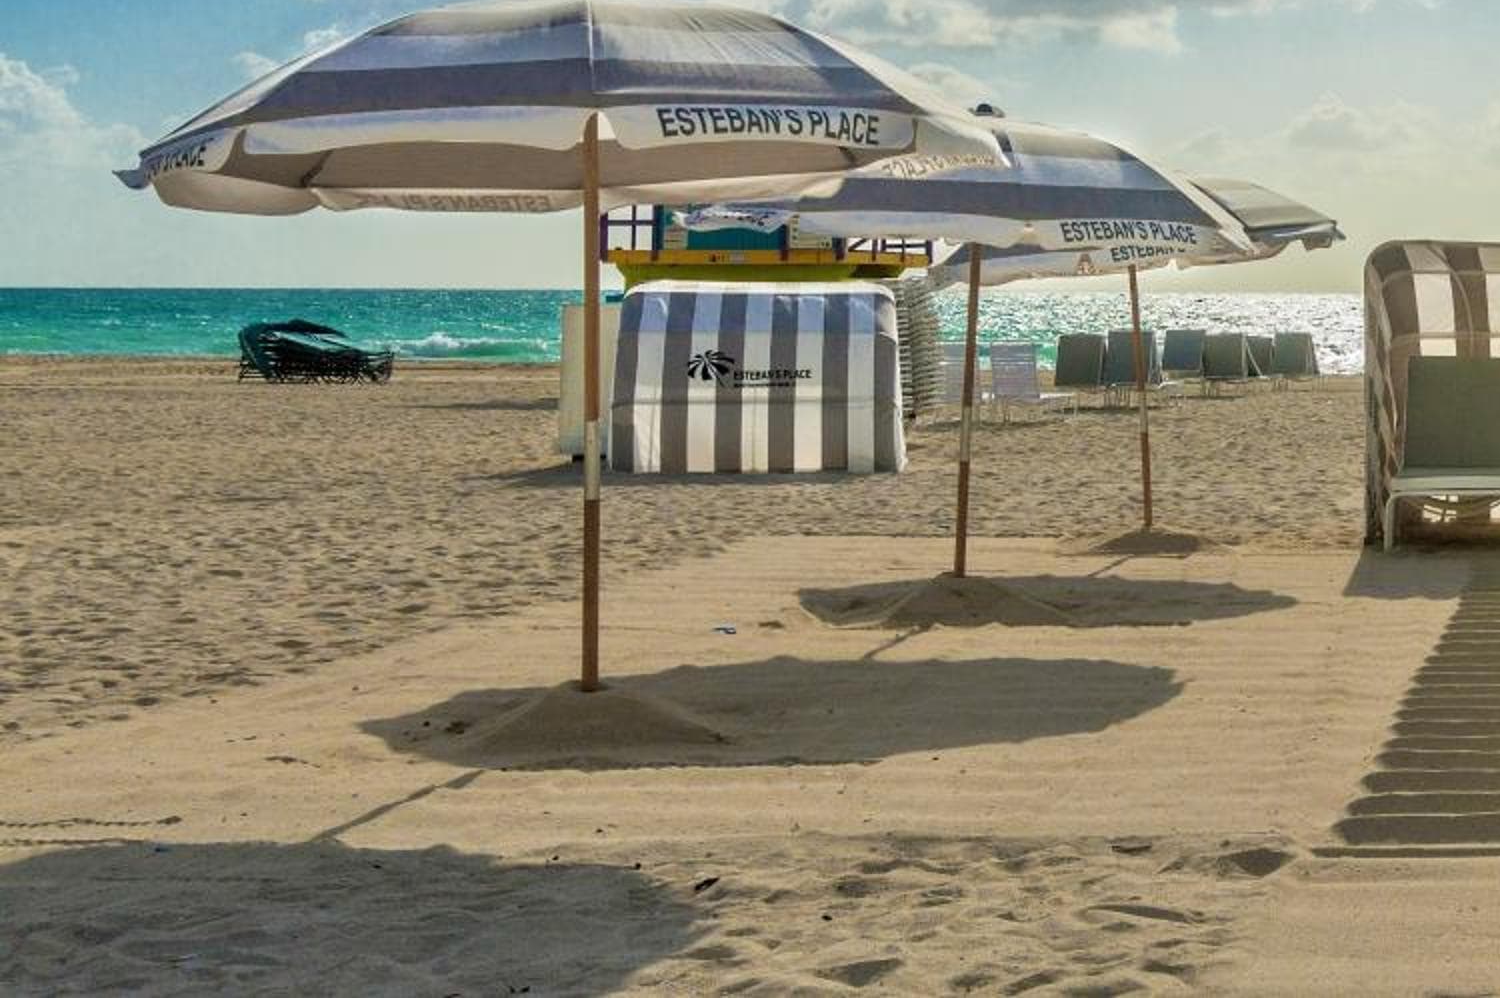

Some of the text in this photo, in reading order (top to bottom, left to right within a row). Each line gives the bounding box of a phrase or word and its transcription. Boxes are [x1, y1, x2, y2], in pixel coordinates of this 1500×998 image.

[655, 106, 880, 145] ESTEBAN'S PLACE
[1059, 221, 1198, 245] ESTEBAN'S PLACE
